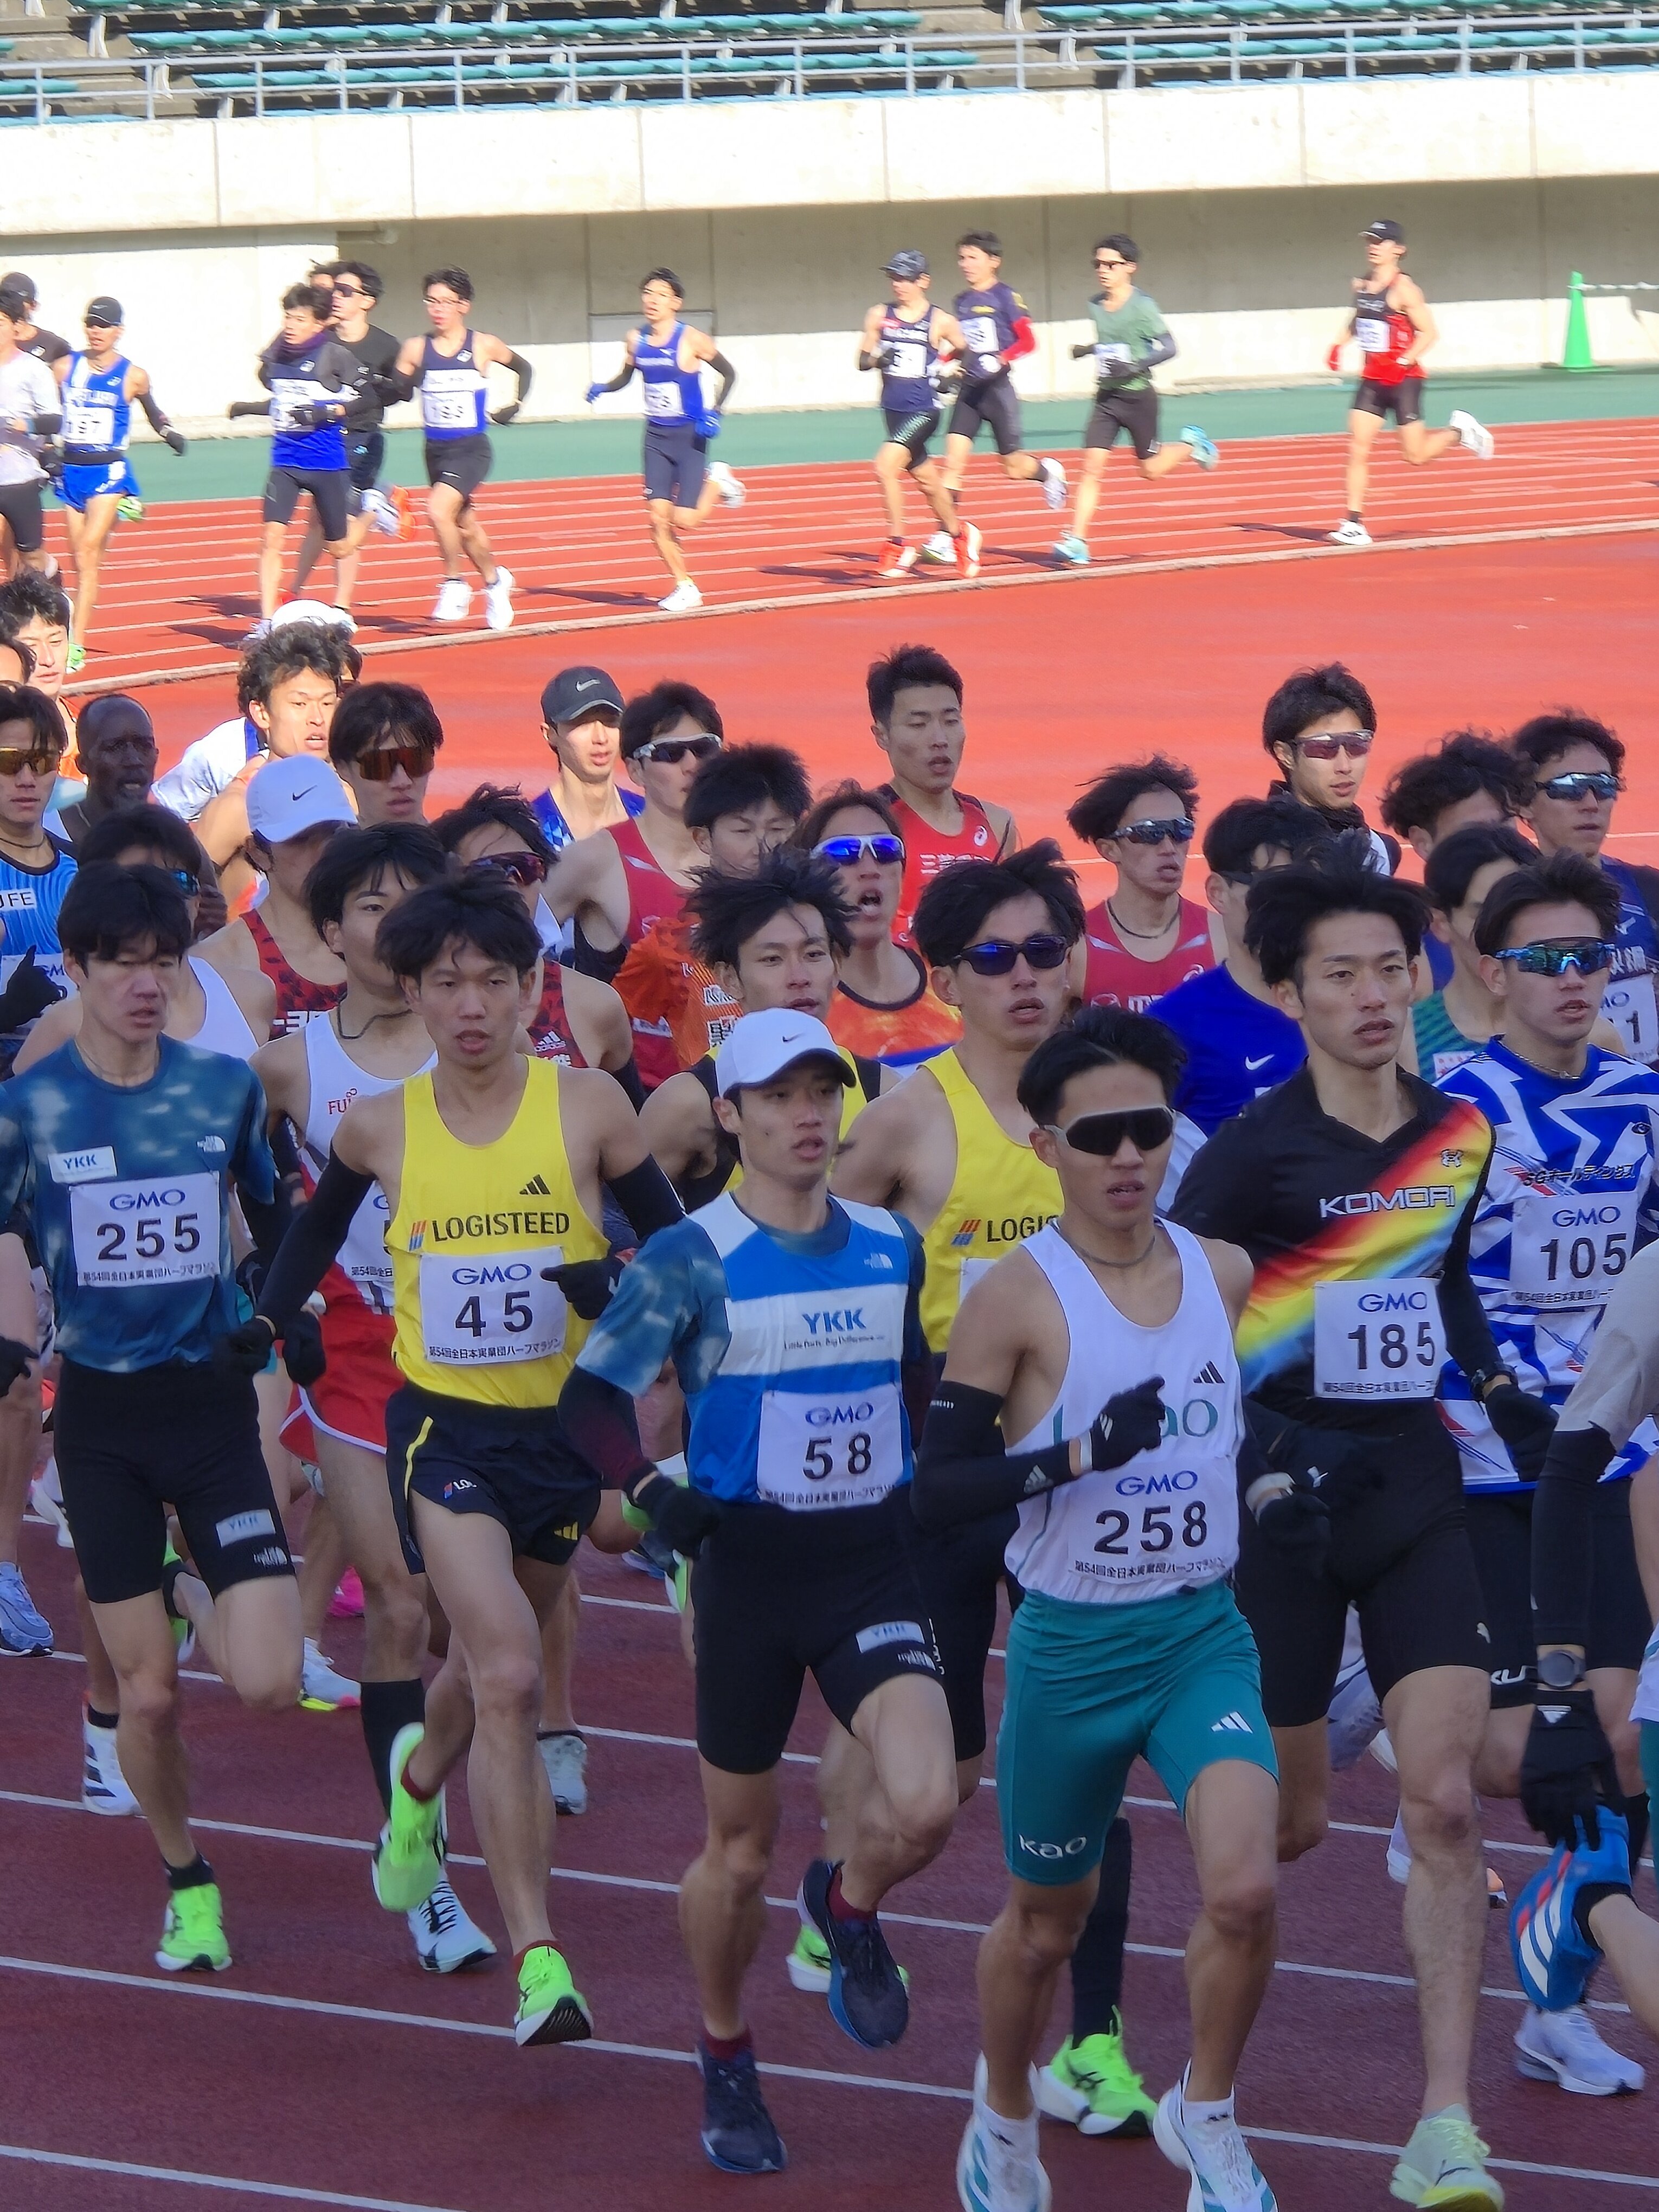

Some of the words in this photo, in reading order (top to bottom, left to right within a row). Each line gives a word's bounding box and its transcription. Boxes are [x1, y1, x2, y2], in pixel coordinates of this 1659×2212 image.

[63, 1155, 97, 1169] YKK
[110, 1189, 185, 1211] GMO
[1319, 1185, 1455, 1218] KOMORI
[432, 1212, 570, 1242] LOGISTEED
[1552, 1206, 1621, 1227] GMO
[97, 1213, 201, 1261] 255
[1540, 1233, 1627, 1281] 105
[452, 1263, 532, 1285] GMO
[455, 1291, 533, 1338] 45
[1358, 1291, 1427, 1313] GMO
[802, 1307, 867, 1334] YKK
[1348, 1321, 1435, 1370] 185
[805, 1402, 874, 1427] GMO
[803, 1432, 872, 1481] 58
[1115, 1470, 1198, 1496] GMO
[1094, 1500, 1207, 1555] 258
